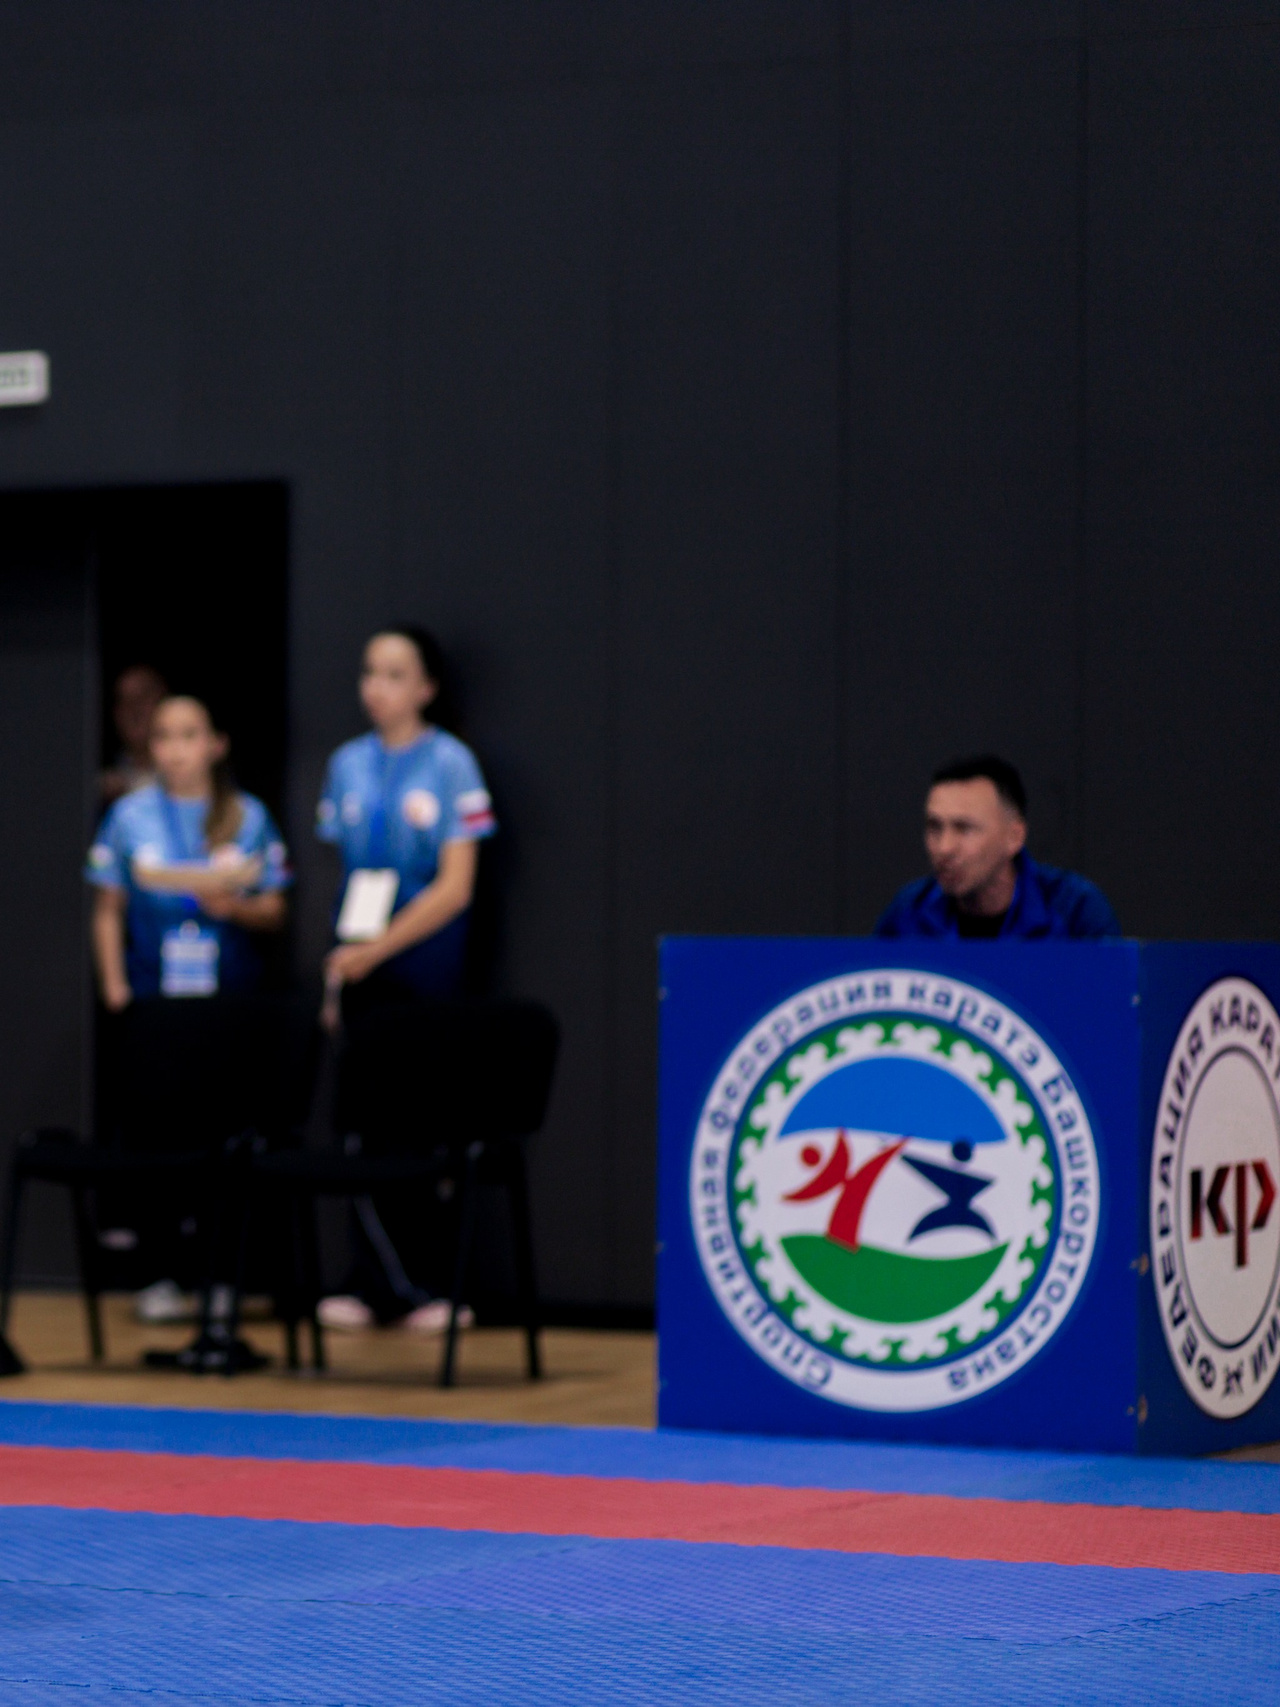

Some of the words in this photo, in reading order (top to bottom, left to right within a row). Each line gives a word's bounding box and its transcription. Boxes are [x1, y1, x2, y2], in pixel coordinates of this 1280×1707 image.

[908, 981, 1039, 1067] каратэ
[948, 1070, 1090, 1390] Башкортостана
[1158, 1026, 1217, 1390] ФЕДЕРАЦИЯ
